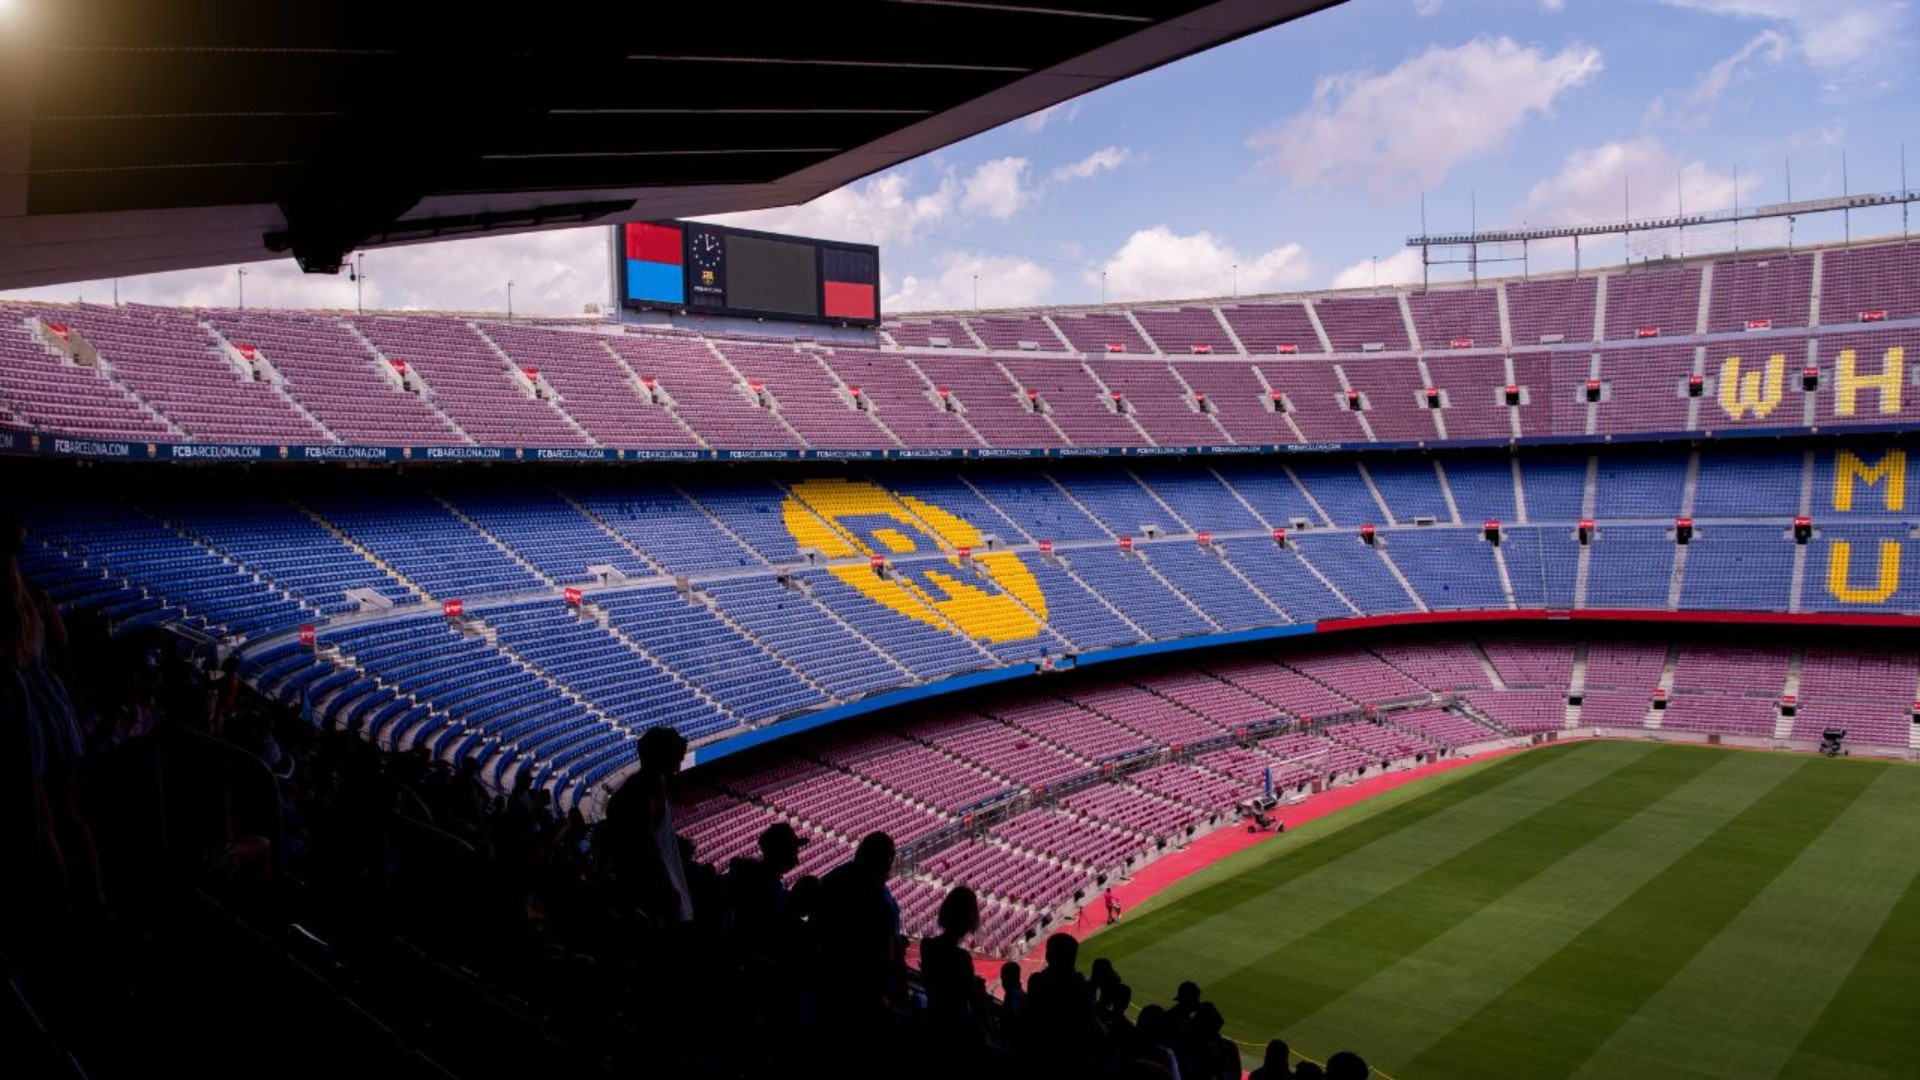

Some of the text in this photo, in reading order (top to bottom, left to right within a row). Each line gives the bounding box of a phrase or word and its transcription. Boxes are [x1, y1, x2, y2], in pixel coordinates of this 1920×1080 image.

[55, 438, 129, 456] FCBARCELONA.COM
[173, 446, 261, 457] FCBARCELONA.COM
[305, 446, 386, 458] FCBARCELONA.COM
[427, 448, 500, 459] FCBARCELONA.COM
[538, 449, 604, 459] FCBARCELONA.COM
[1833, 450, 1906, 511] M
[1827, 540, 1902, 603] U
